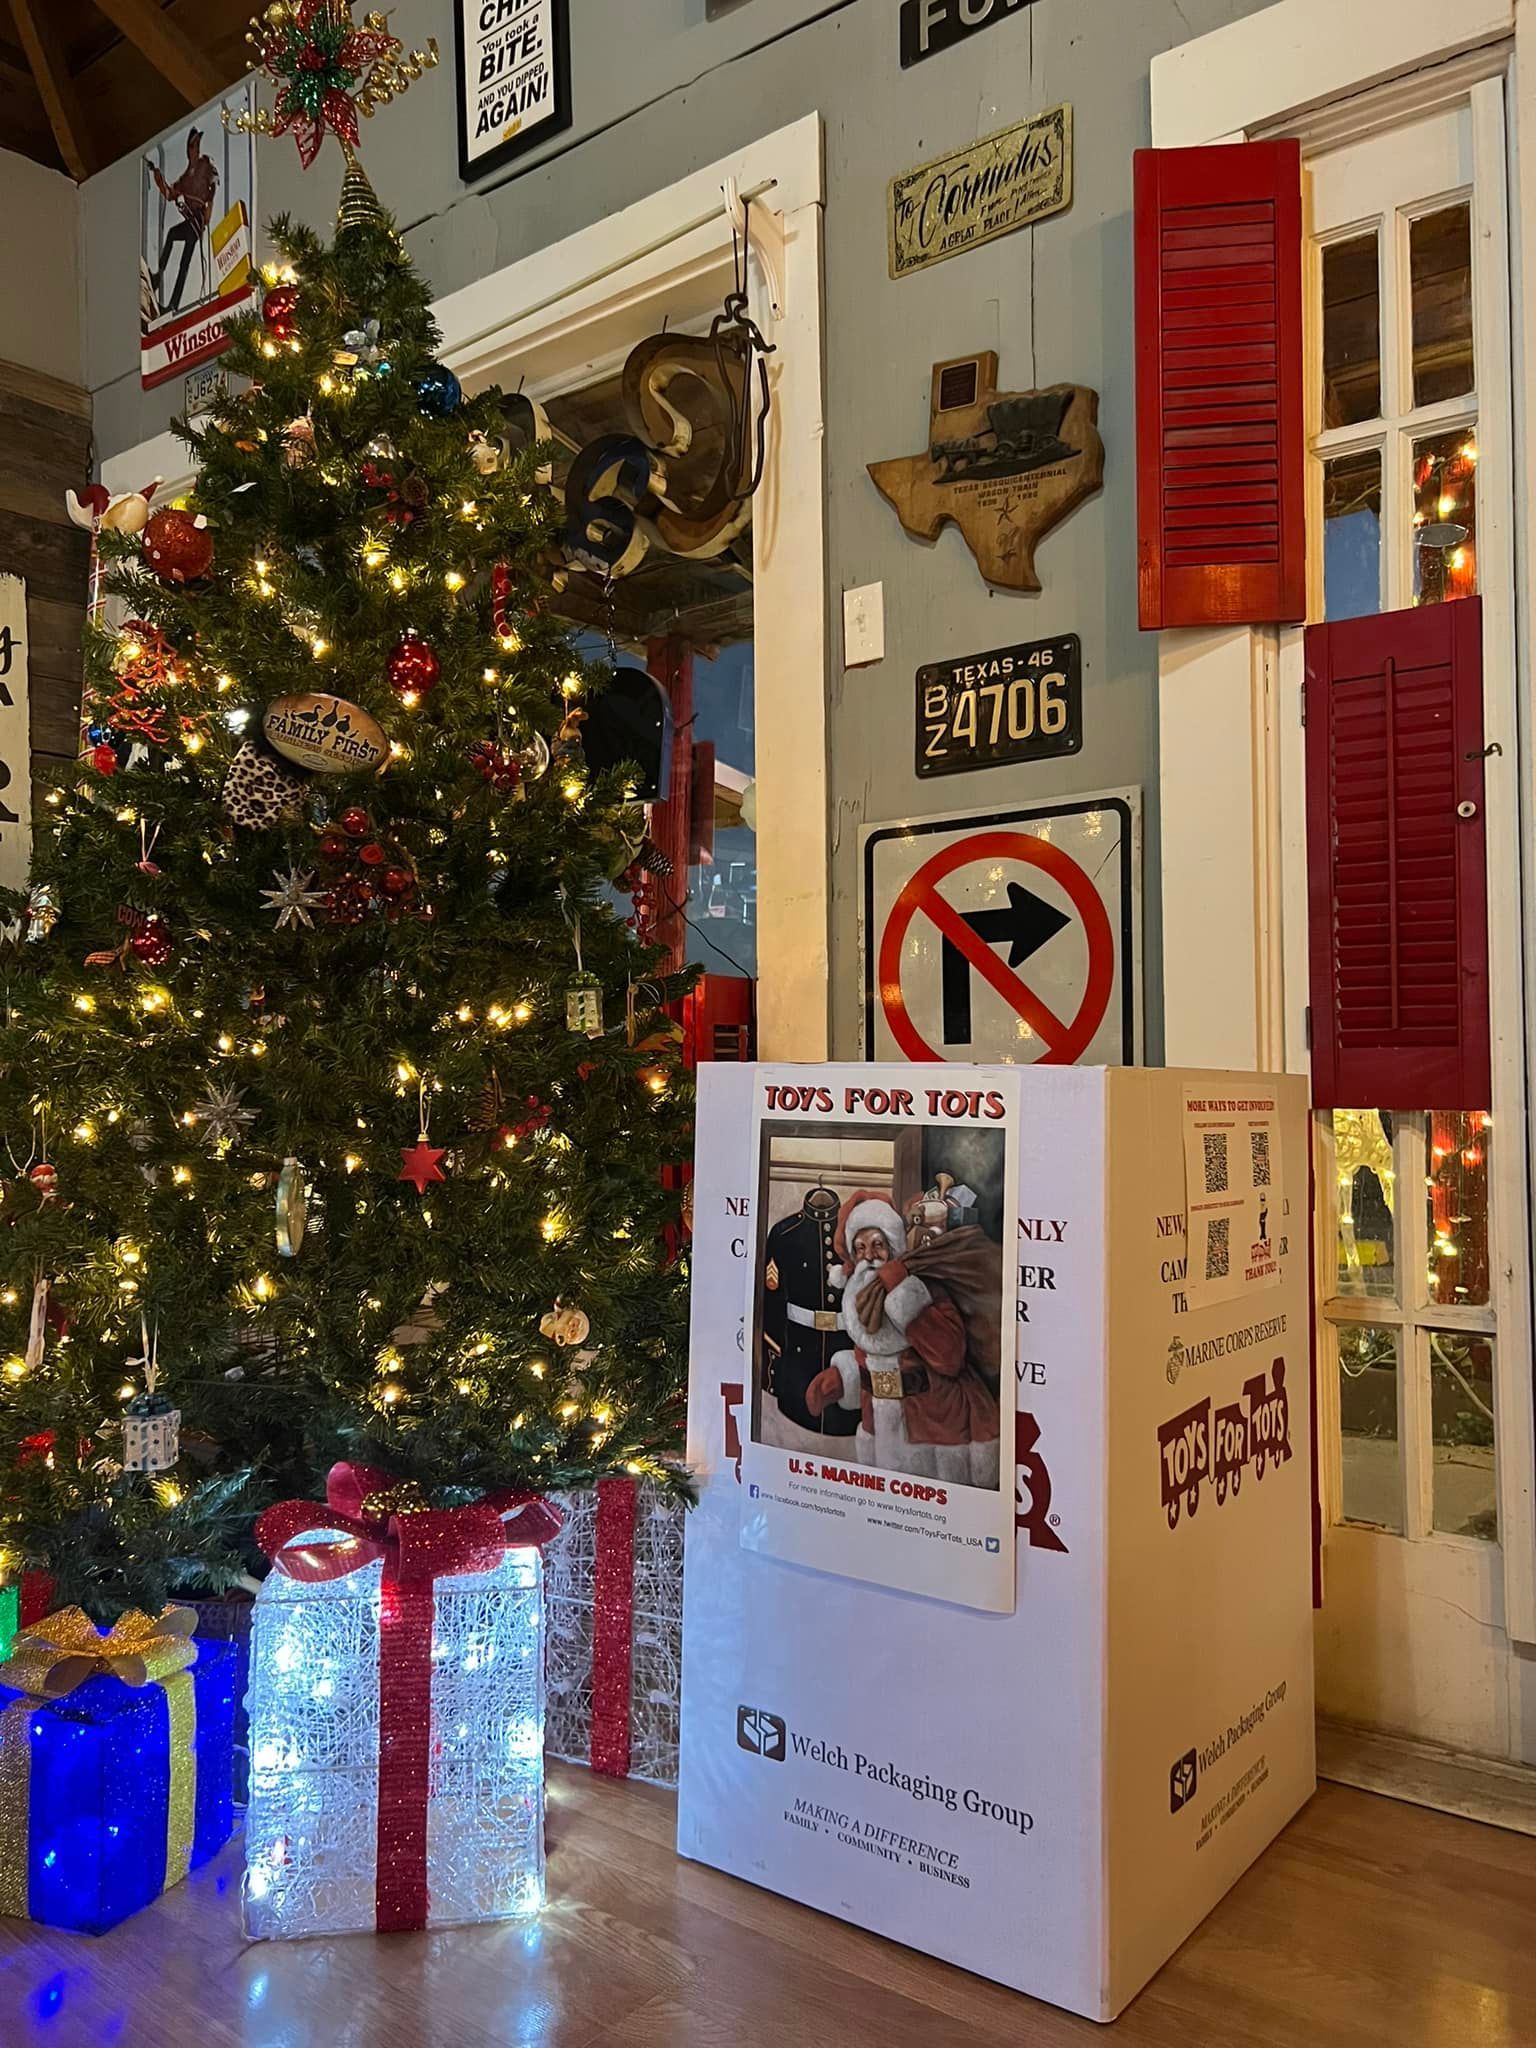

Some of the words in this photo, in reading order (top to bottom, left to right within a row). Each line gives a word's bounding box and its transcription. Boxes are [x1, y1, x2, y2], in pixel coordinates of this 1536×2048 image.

[479, 25, 543, 84] BITE.
[482, 37, 501, 54] You
[505, 19, 529, 41] took
[532, 14, 539, 24] a
[475, 71, 549, 138] AGAIN!
[478, 92, 495, 112] AND
[497, 80, 514, 99] YOU
[515, 62, 544, 88] DIPPED
[165, 320, 226, 363] Winsto
[952, 672, 1067, 748] 4706
[267, 715, 330, 745] FAMILY
[332, 735, 379, 762] FIRST
[764, 1085, 834, 1113] TOYS
[844, 1087, 915, 1116] FOR
[925, 1089, 1006, 1120] TOTS
[1187, 1100, 1207, 1112] MORE
[1208, 1100, 1226, 1111] WAYS
[1228, 1100, 1236, 1111] TO
[1017, 1218, 1068, 1243] NLY
[1185, 1336, 1225, 1368] MARINE
[1226, 1324, 1253, 1355] CORPS
[1254, 1314, 1287, 1344] RESERVE
[1163, 1421, 1207, 1487] TOYS
[1215, 1418, 1243, 1462] FOR
[1252, 1398, 1284, 1442] TOTS
[788, 1481, 799, 1490] For
[801, 1485, 818, 1494] more
[820, 1486, 856, 1503] information
[857, 1498, 867, 1506] go
[868, 1499, 876, 1508] to
[789, 1458, 818, 1477] U.S.
[821, 1464, 885, 1492] MARINE
[890, 1479, 948, 1505] CORPS
[1198, 1735, 1226, 1774] Welch
[1226, 1702, 1265, 1748] Packaging
[1265, 1680, 1287, 1711] Group
[791, 1733, 849, 1771] Welch
[854, 1753, 958, 1811] Packaging
[963, 1789, 1034, 1835] Group
[784, 1811, 819, 1832] FAMILY
[837, 1831, 902, 1864] COMMUNITY
[919, 1861, 970, 1889] BUSINESS
[793, 1798, 849, 1829] MAKING
[851, 1820, 860, 1834] A
[864, 1823, 960, 1869] DIFFERENCE
